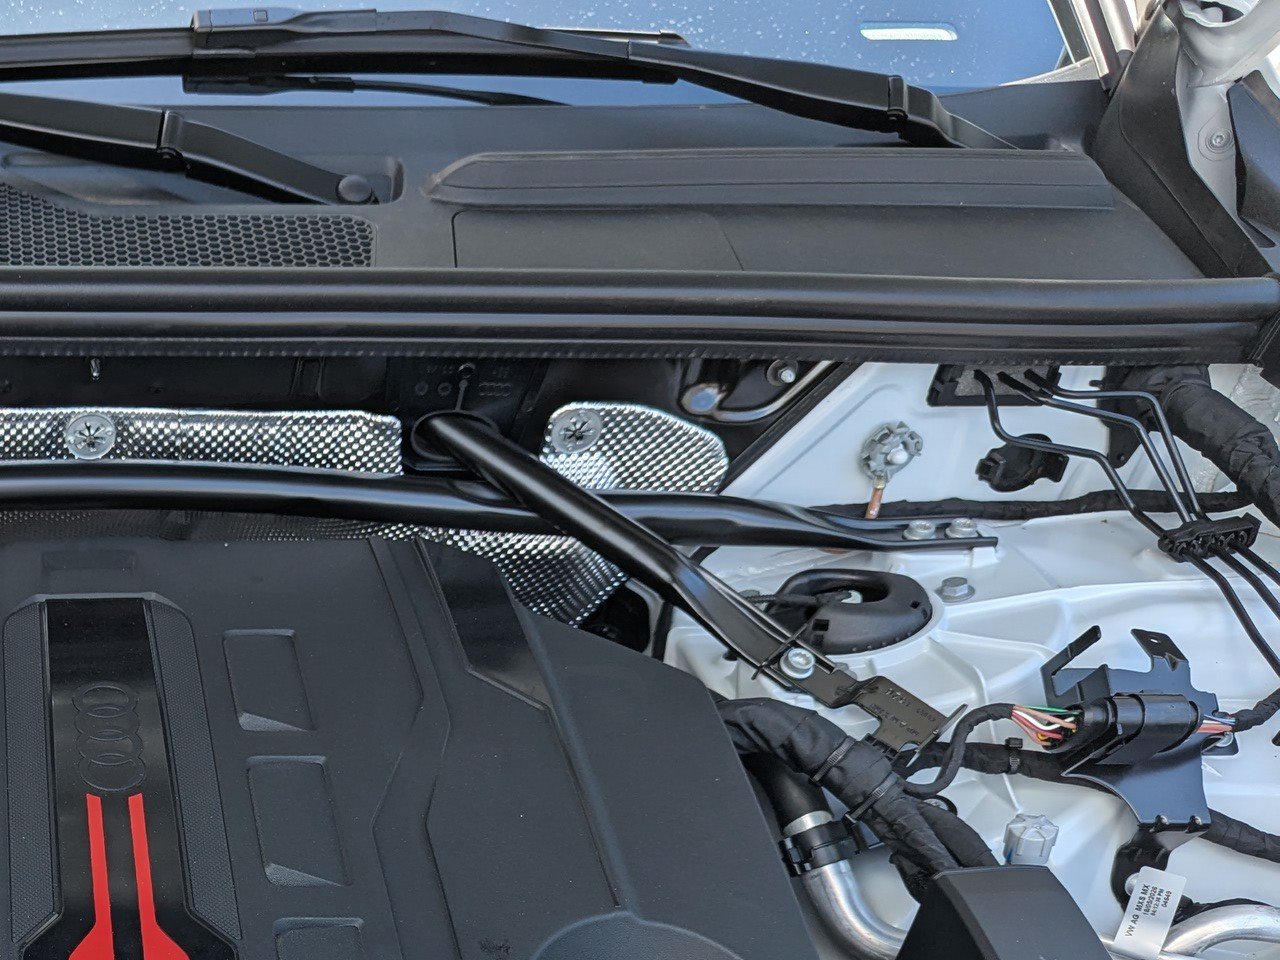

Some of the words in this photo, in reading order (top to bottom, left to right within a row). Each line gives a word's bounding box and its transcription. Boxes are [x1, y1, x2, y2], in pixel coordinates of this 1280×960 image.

[1141, 884, 1151, 896] MX
[1135, 896, 1146, 912] MXS
[1131, 914, 1140, 925] AG
[1125, 925, 1135, 937] VW
